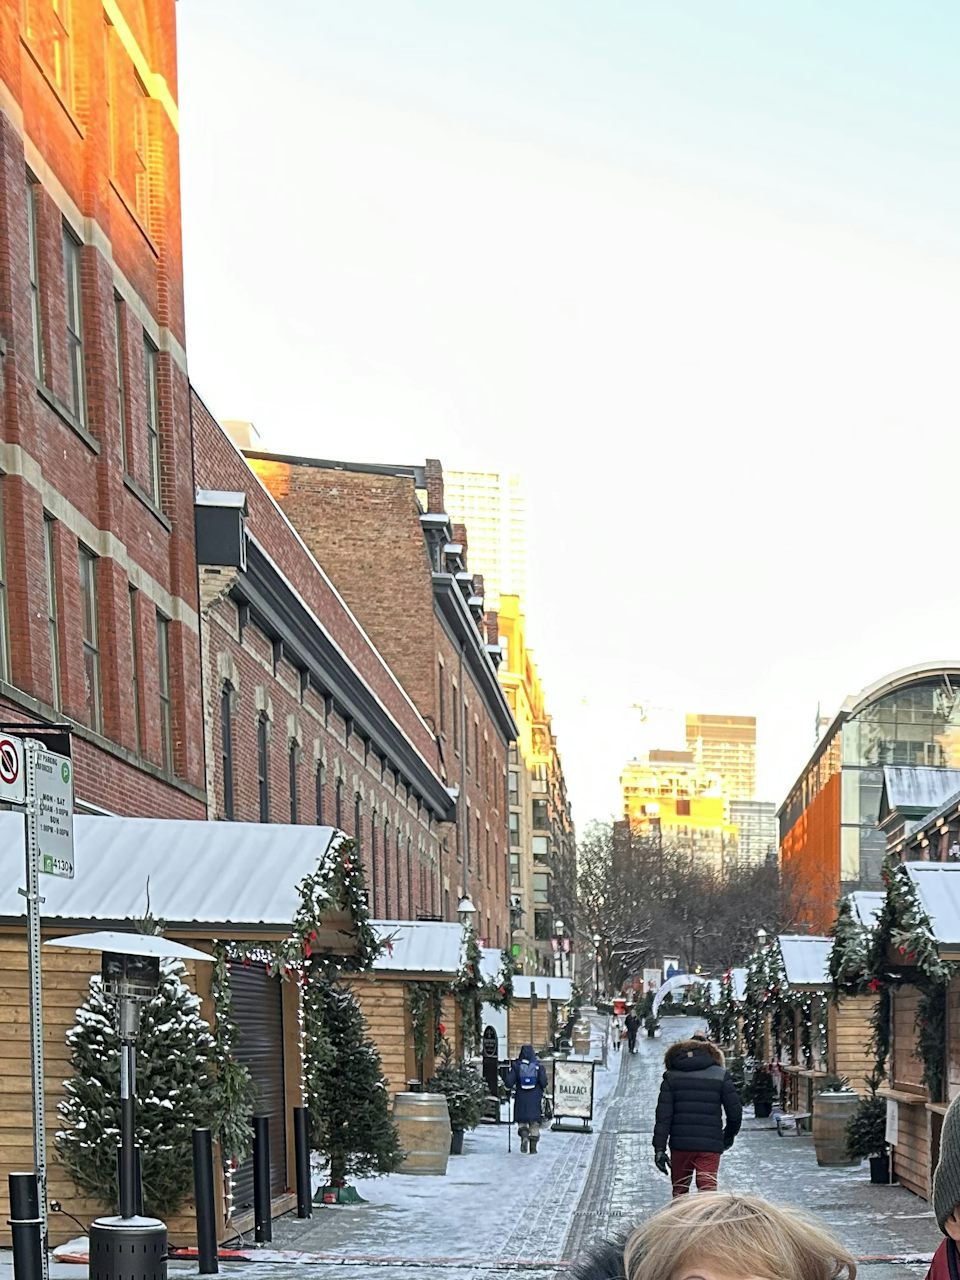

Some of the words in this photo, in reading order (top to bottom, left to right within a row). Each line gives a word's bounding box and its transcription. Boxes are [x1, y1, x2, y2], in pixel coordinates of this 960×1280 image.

[42, 793, 53, 803] MON
[56, 797, 65, 806] SAT
[49, 815, 60, 824] SUN
[53, 858, 69, 872] 4130
